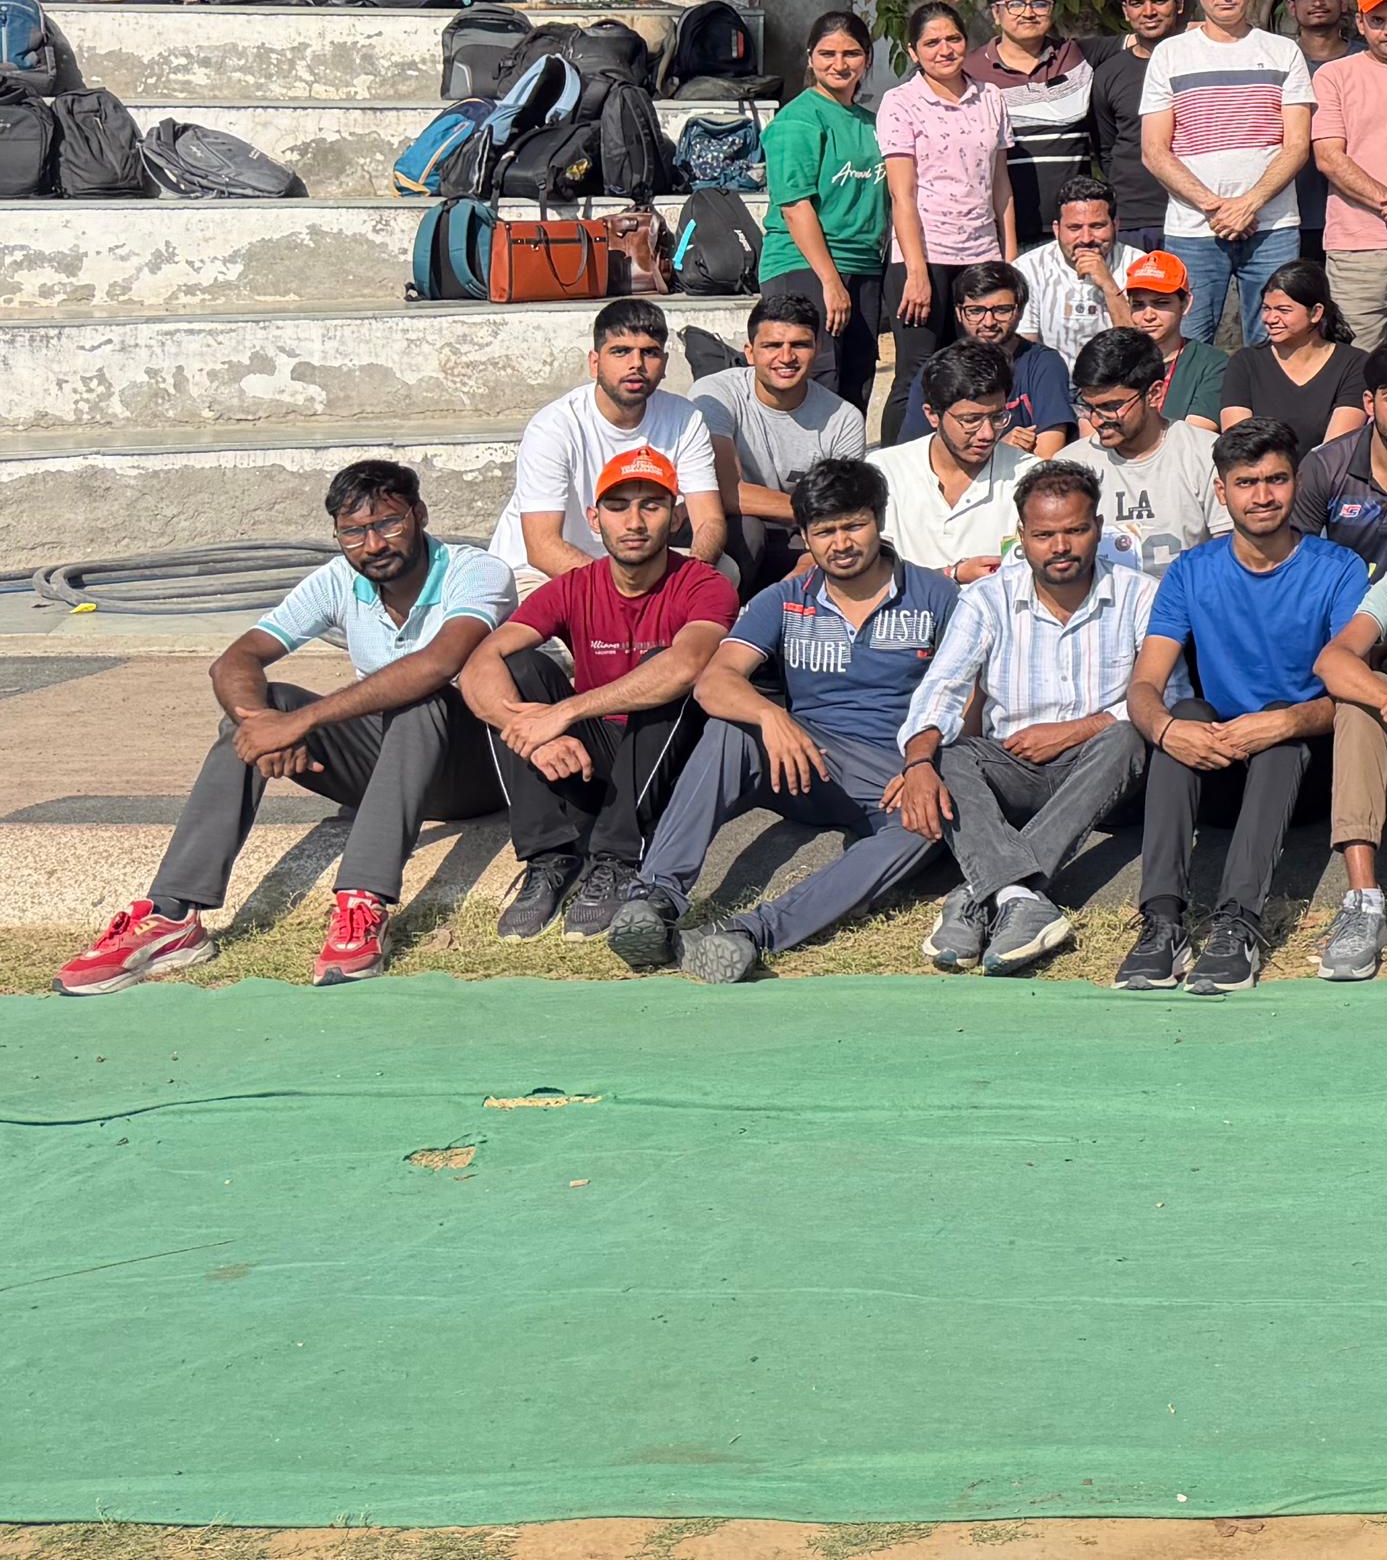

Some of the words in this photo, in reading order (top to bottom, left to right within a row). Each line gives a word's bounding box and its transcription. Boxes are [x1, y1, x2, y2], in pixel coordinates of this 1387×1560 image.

[1116, 490, 1155, 521] LA
[875, 609, 934, 642] VISIO
[785, 638, 847, 673] UTURE
